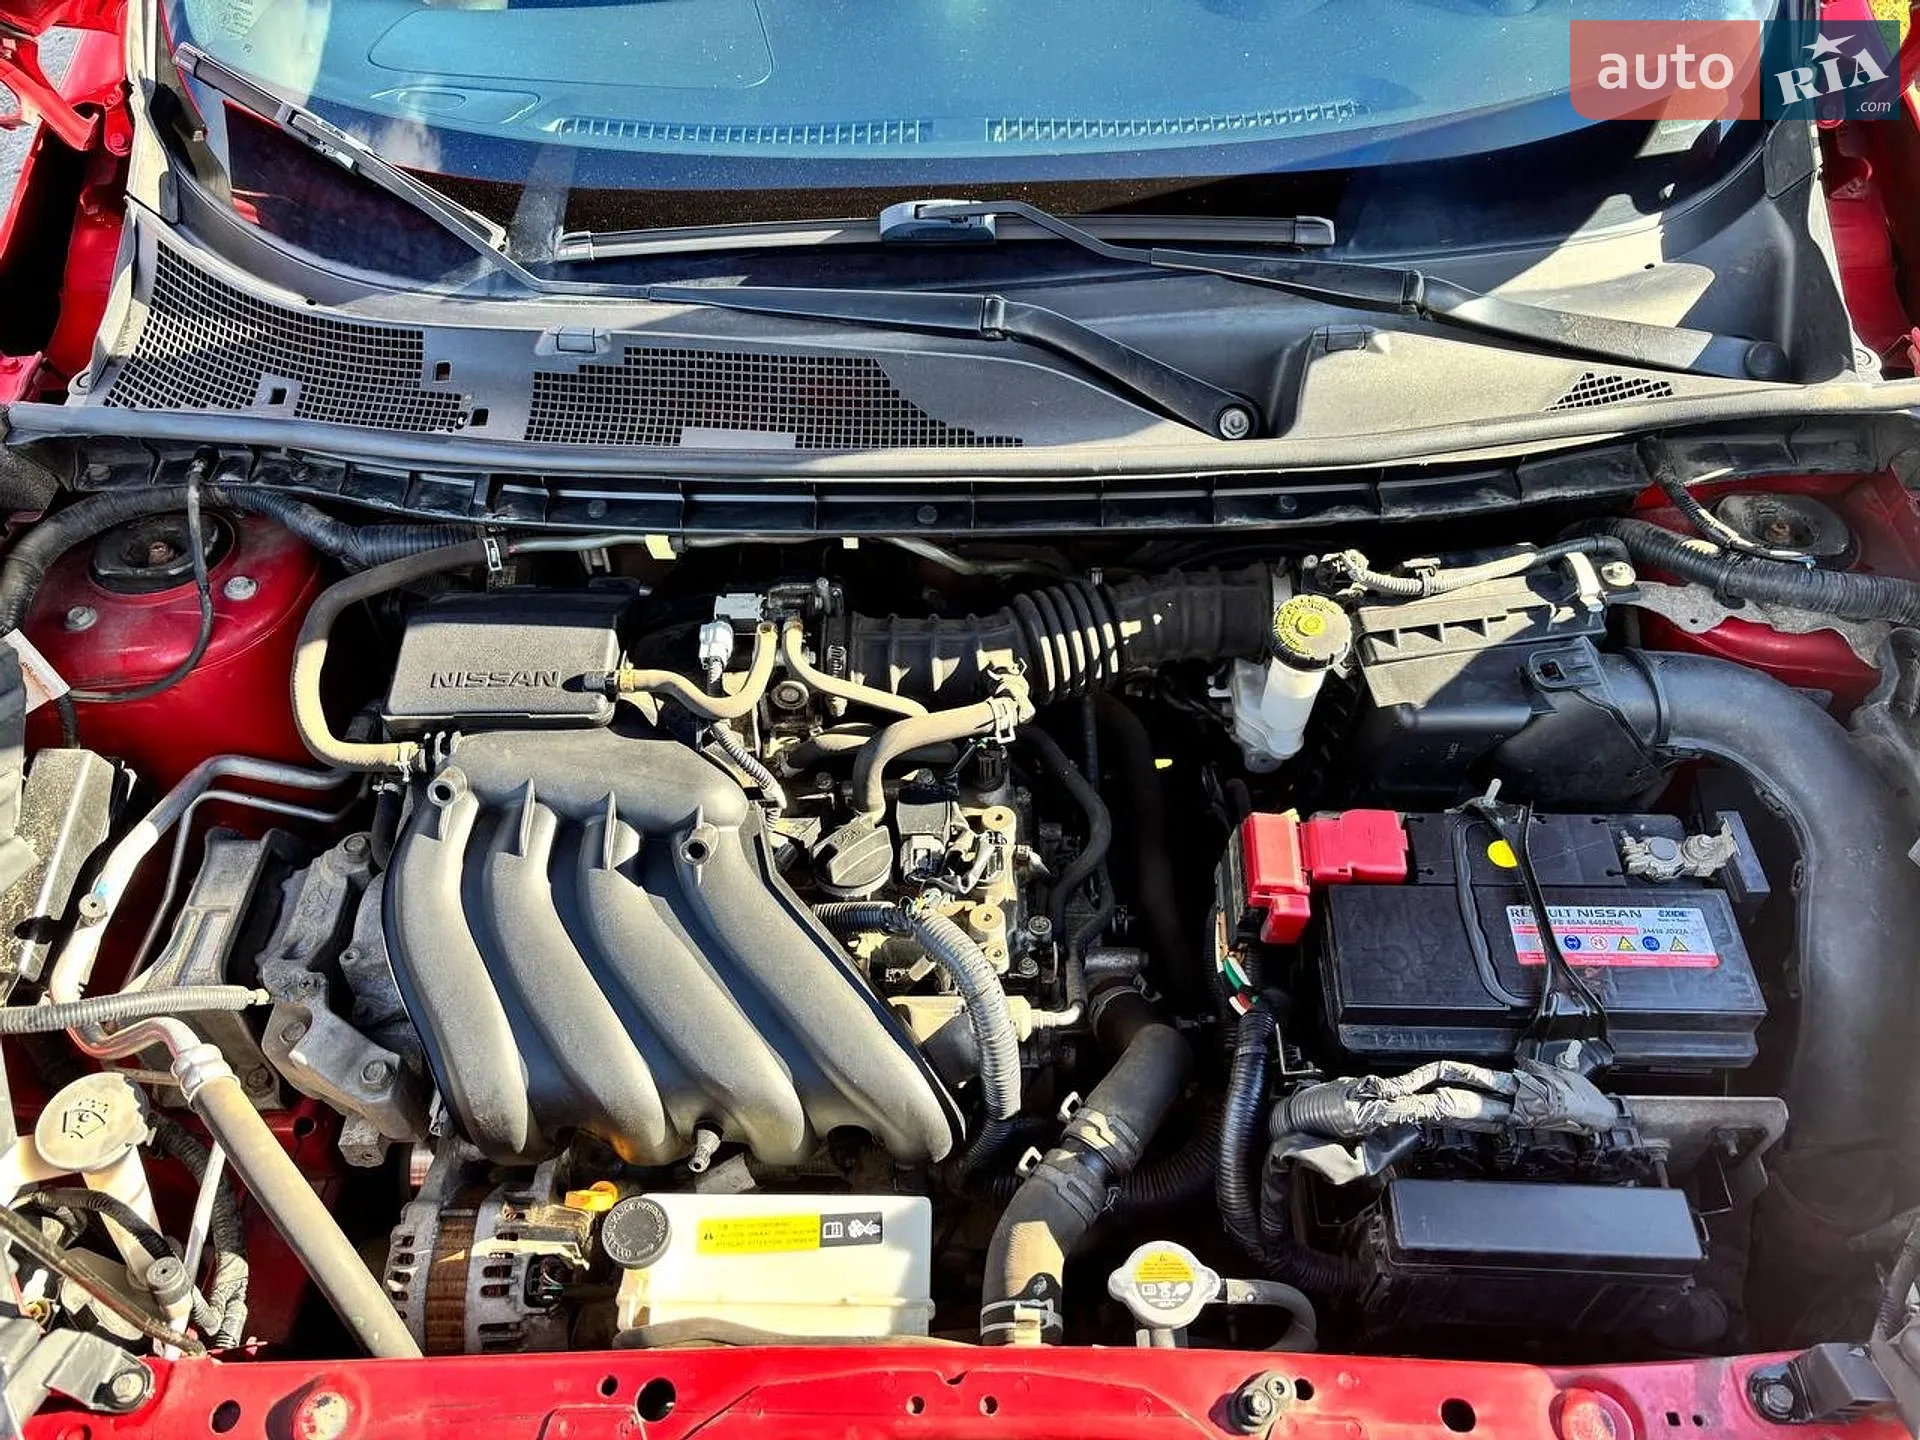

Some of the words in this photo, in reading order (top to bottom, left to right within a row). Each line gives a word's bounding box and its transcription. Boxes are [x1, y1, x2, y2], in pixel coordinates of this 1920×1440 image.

[430, 671, 560, 688] NISSAN
[1510, 908, 1570, 918] REULT
[1577, 908, 1642, 918] NISSAN
